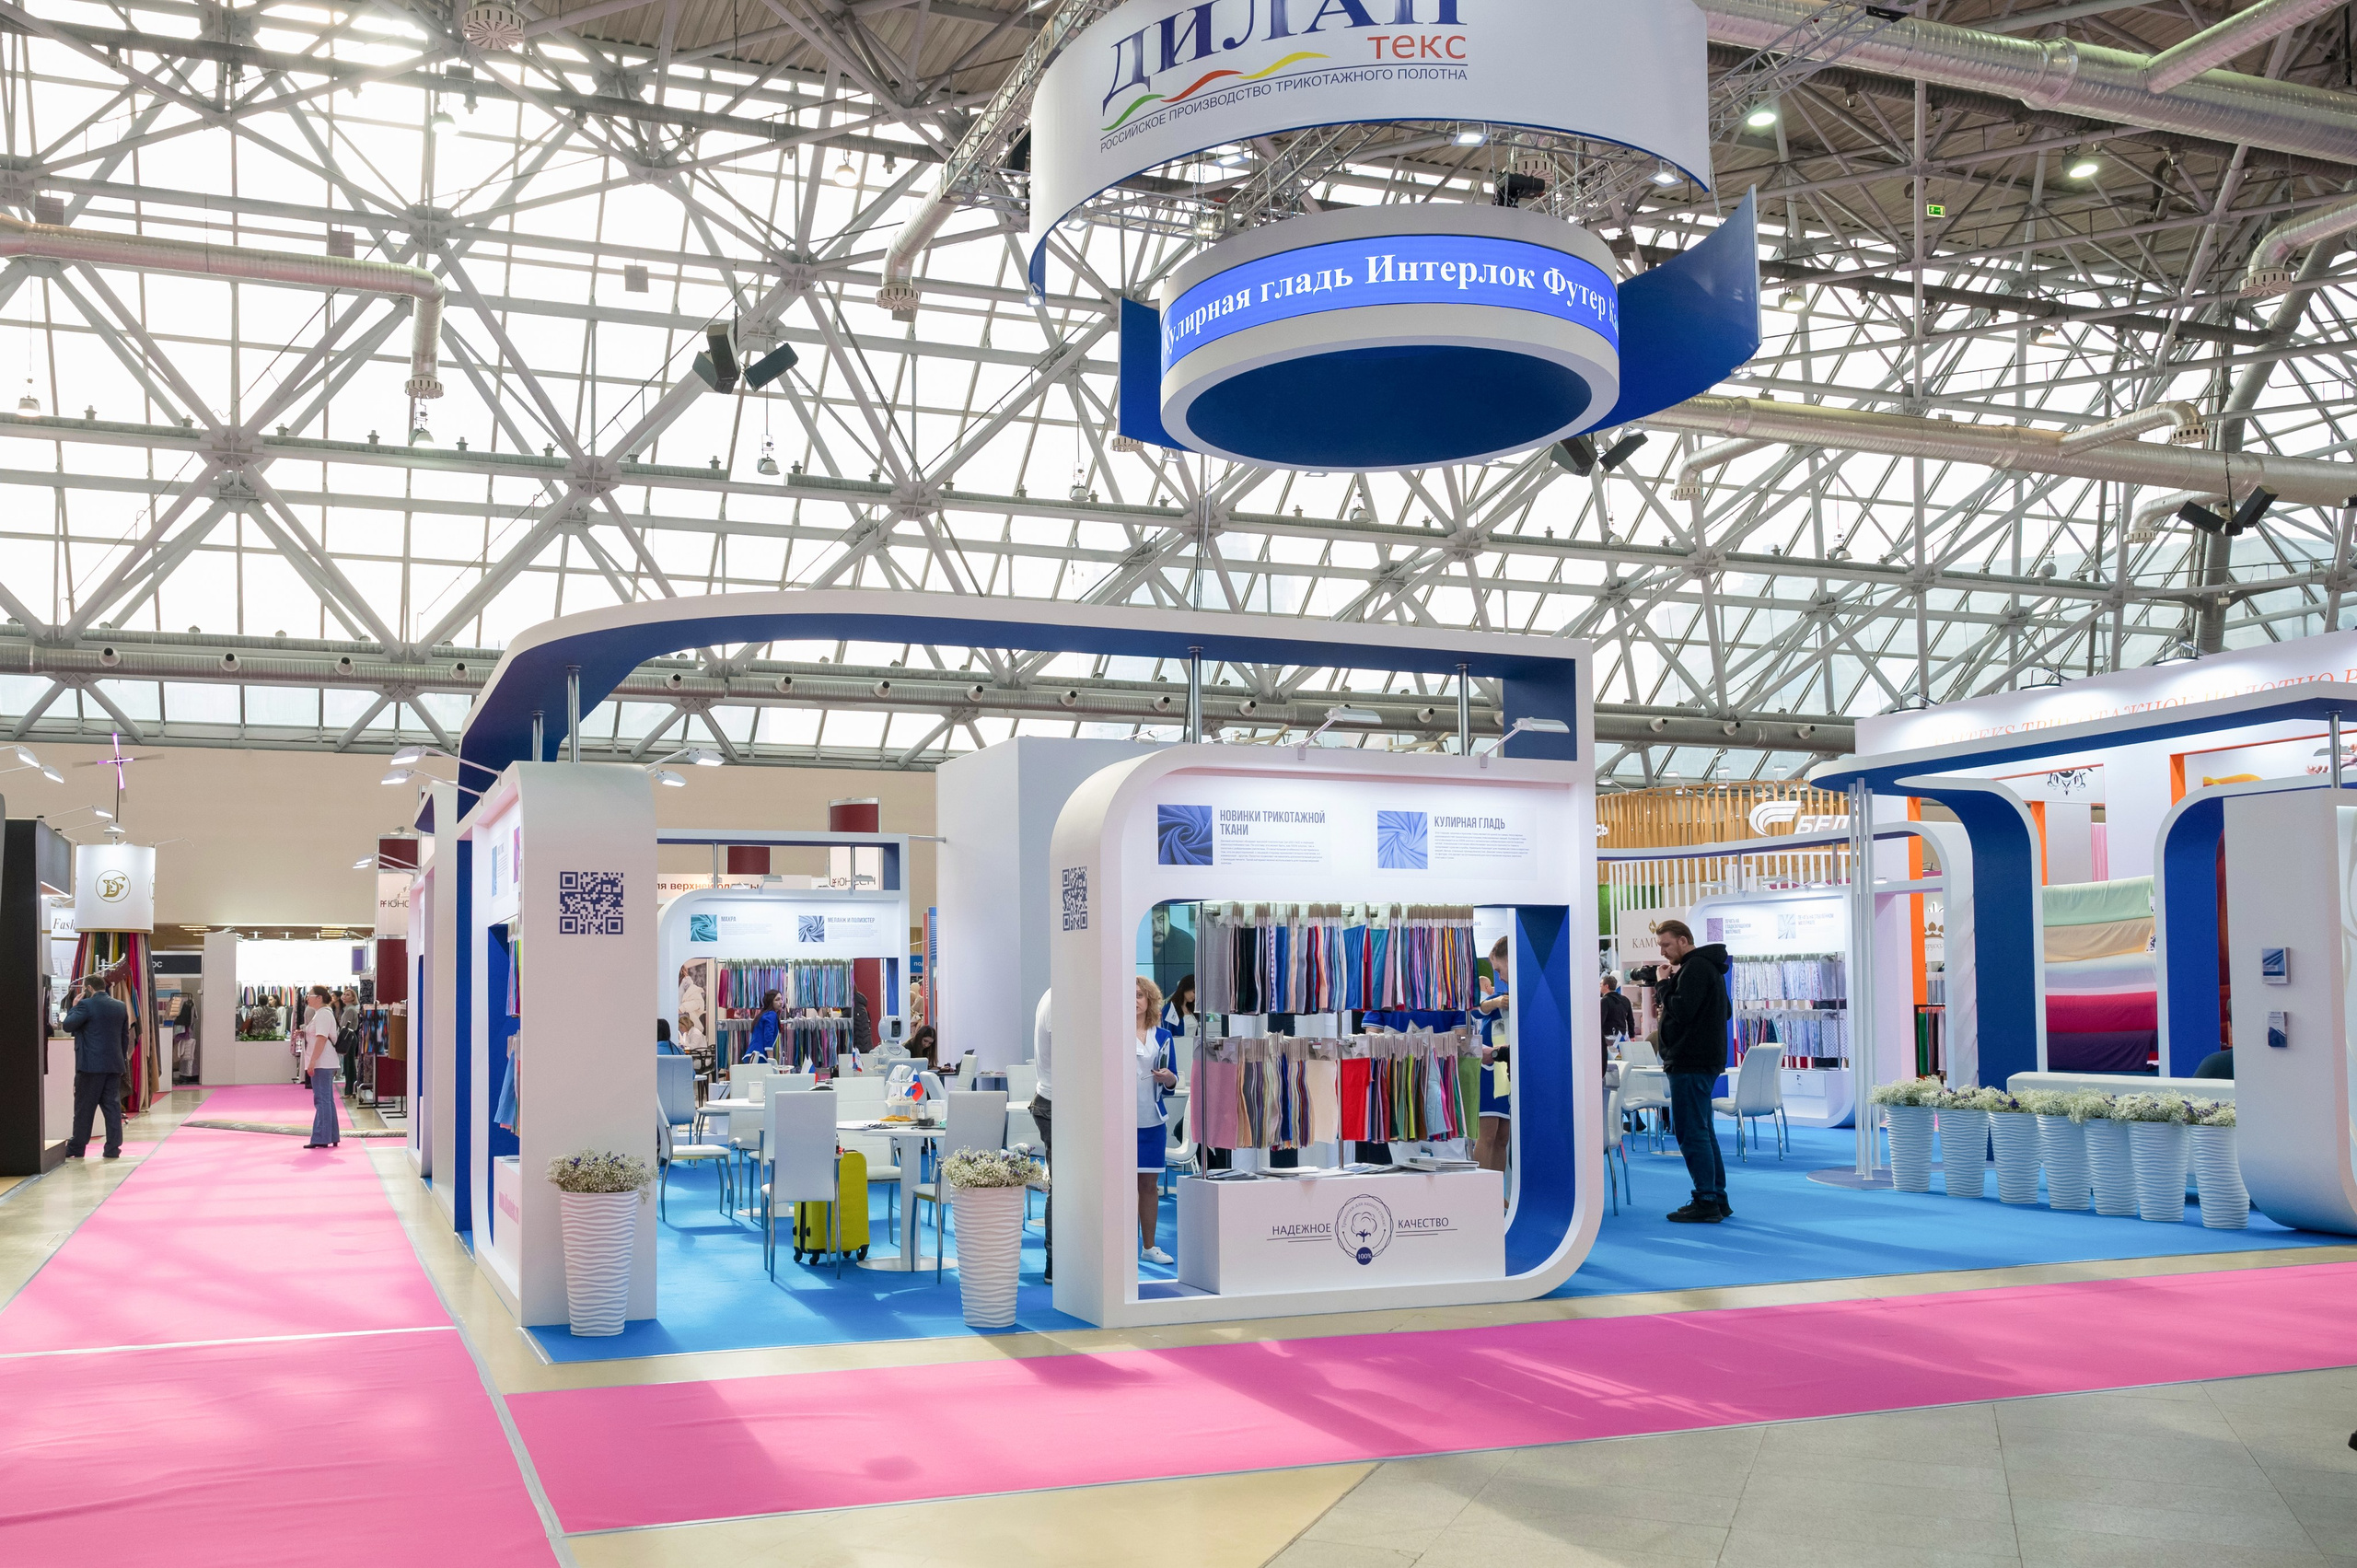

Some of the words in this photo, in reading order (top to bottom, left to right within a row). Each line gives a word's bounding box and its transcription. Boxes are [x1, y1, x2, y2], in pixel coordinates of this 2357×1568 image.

[1367, 35, 1467, 60] текс
[1099, 112, 1167, 153] РОССИЙСКОЕ
[1169, 84, 1271, 122] ПРОИЗВОДСТВО
[1275, 69, 1394, 92] ТРИКОТАЖНОГО
[1398, 68, 1468, 81] ПОЛОТНА
[1260, 268, 1353, 304] гладь
[1364, 254, 1535, 290] Интерлок
[1543, 267, 1606, 322] Футер
[1220, 809, 1260, 822] НОВИНКИ
[1262, 810, 1326, 824] ТРИКОТАЖНОЙ
[1434, 816, 1477, 829] КУЛИРНАЯ
[1479, 818, 1505, 830] ГЛАДЬ
[1220, 823, 1248, 835] ТКАНИ
[1271, 1223, 1331, 1237] НАДЕЖНОЕ
[1398, 1217, 1449, 1229] КАЧЕСТВО
